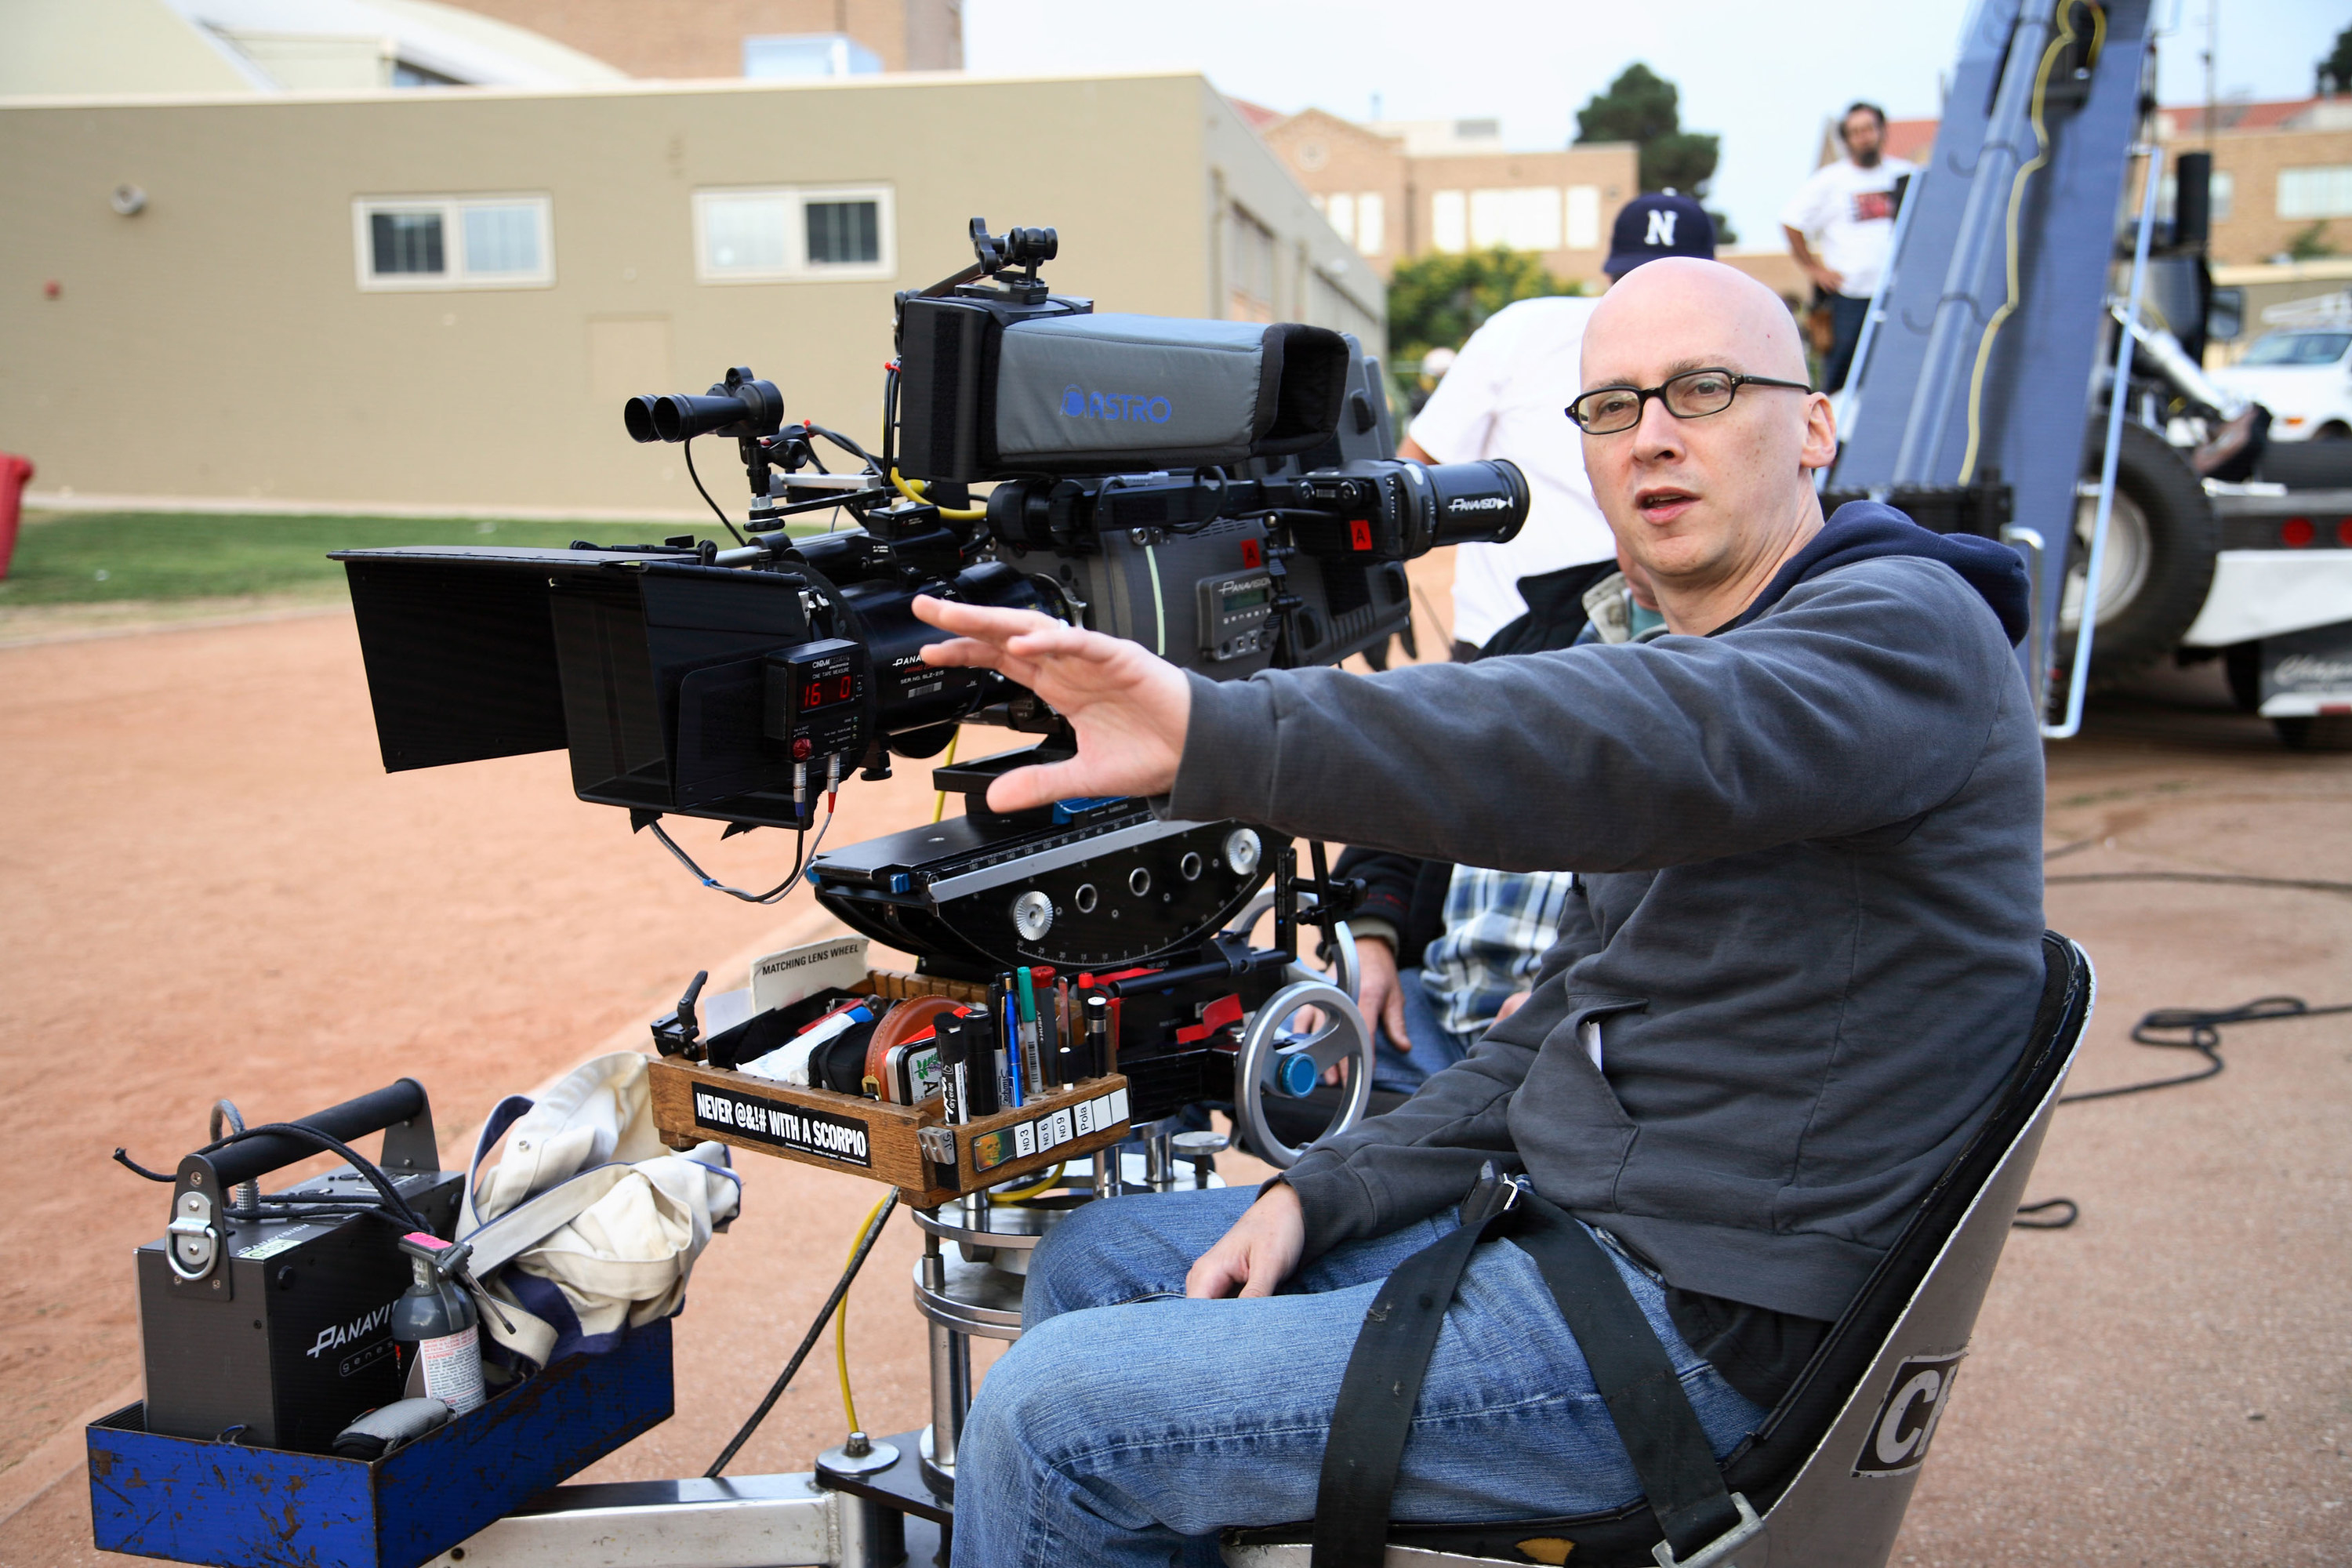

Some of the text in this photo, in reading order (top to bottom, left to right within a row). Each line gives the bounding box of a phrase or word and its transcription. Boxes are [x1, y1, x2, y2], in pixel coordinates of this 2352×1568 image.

[1644, 209, 1679, 246] N
[1089, 391, 1172, 424] ASTRO
[1356, 528, 1366, 543] A
[1247, 548, 1256, 561] A
[804, 675, 851, 707] 16 0
[762, 943, 859, 975] MATCHING LENS WHEEL
[948, 1098, 956, 1109] dry
[1080, 1105, 1089, 1131] Pola
[696, 1092, 734, 1125] NEVER
[735, 1102, 767, 1134] @&!#
[768, 1109, 800, 1142] WITH
[802, 1117, 812, 1145] A
[813, 1120, 867, 1158] SCORPIO
[343, 1341, 394, 1373] genes
